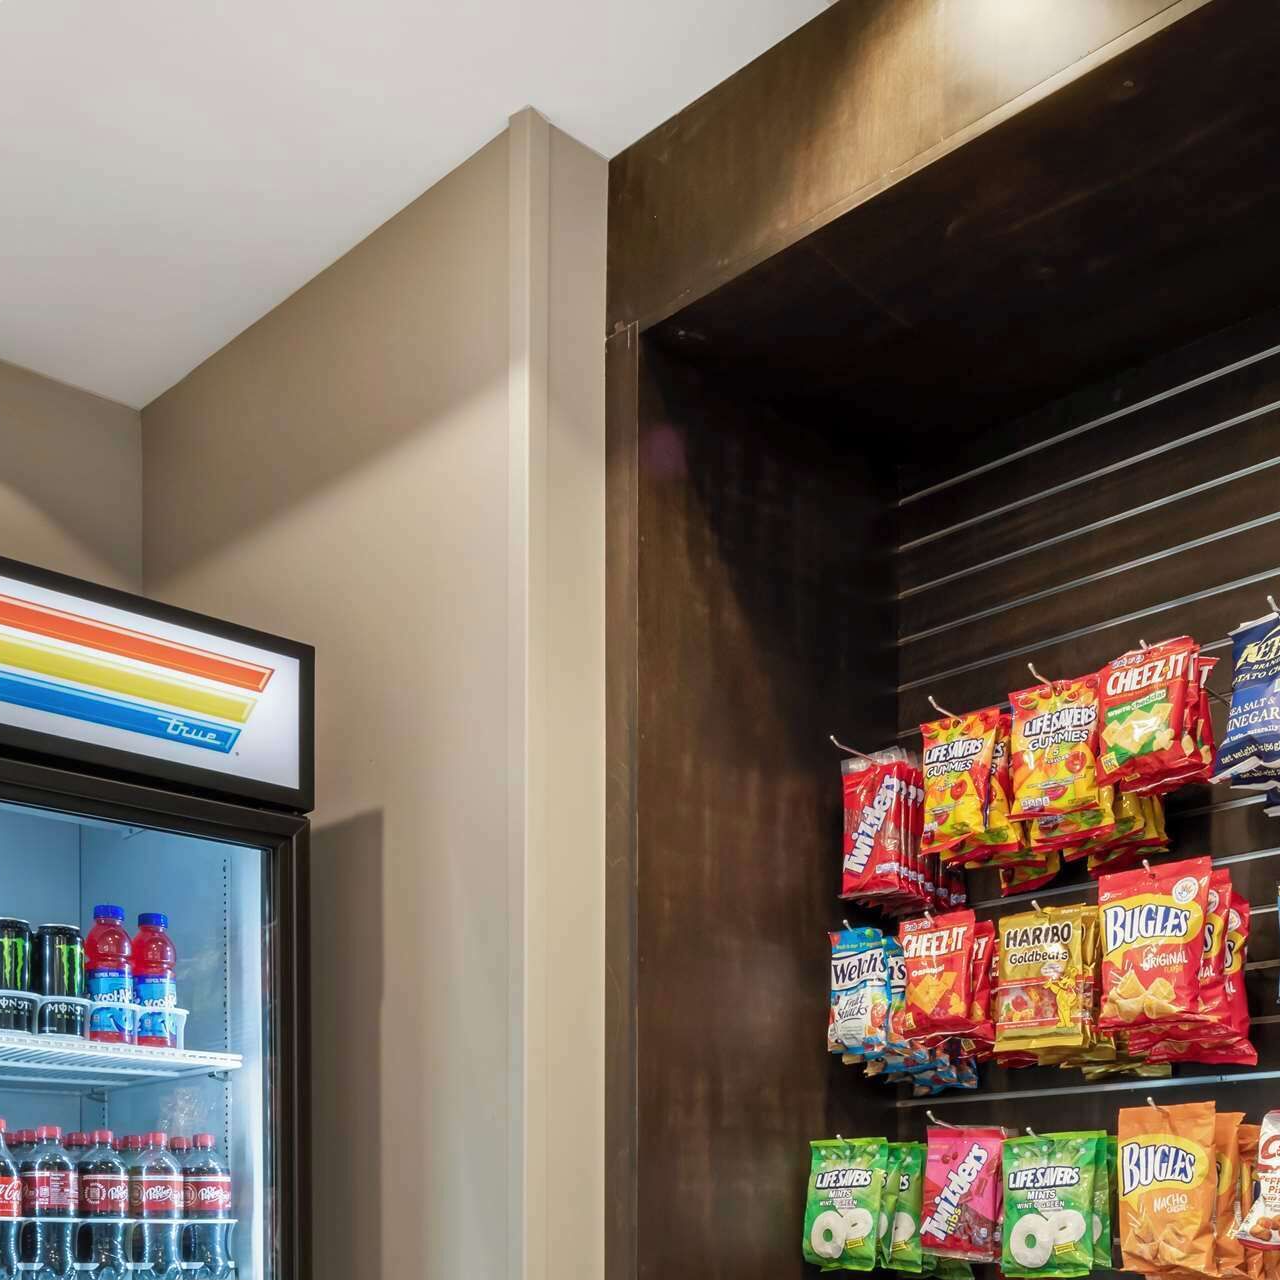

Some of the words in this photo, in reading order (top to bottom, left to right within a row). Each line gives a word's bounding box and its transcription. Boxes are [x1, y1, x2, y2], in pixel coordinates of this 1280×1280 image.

[1244, 699, 1265, 711] SALT
[1028, 730, 1089, 751] GUMMIES
[926, 759, 974, 779] GUMMIES
[1005, 922, 1072, 949] HARIBO
[1104, 903, 1190, 956] BUGLES
[832, 953, 886, 984] Welch's
[1009, 951, 1068, 966] Goldbears
[1122, 1142, 1194, 1197] BUGLES
[828, 1189, 853, 1199] MINTS
[1026, 1189, 1056, 1200] MINTS
[1153, 1193, 1188, 1210] NACHO
